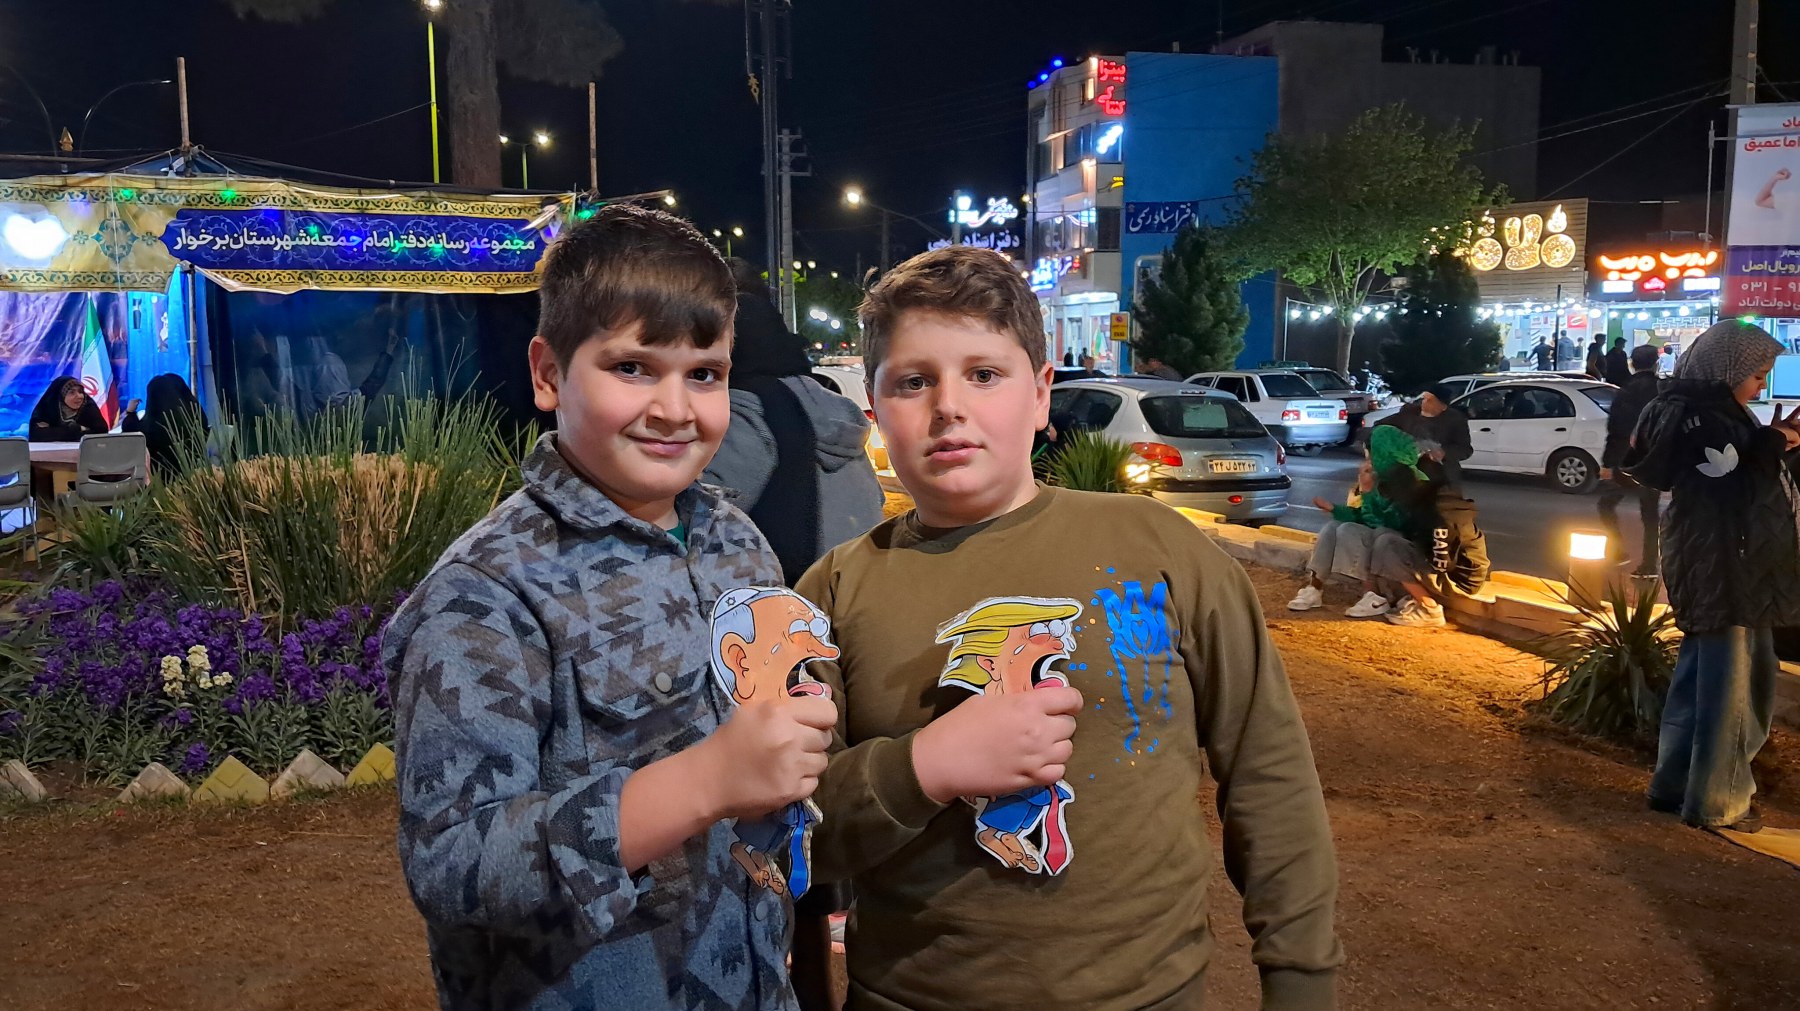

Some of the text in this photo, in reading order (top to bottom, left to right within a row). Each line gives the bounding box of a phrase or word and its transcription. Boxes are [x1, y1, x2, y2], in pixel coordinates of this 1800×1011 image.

[1100, 59, 1126, 83] پیتزا
[1744, 137, 1782, 152] عمیق
[1129, 206, 1152, 233] رسمی
[173, 227, 536, 255] مجموعه رسانه دفتر امام جمعه شهرستان برخوار
[994, 229, 1020, 252] دفتر
[1742, 260, 1768, 273] اصل
[1741, 281, 1768, 292] ۰۳۱
